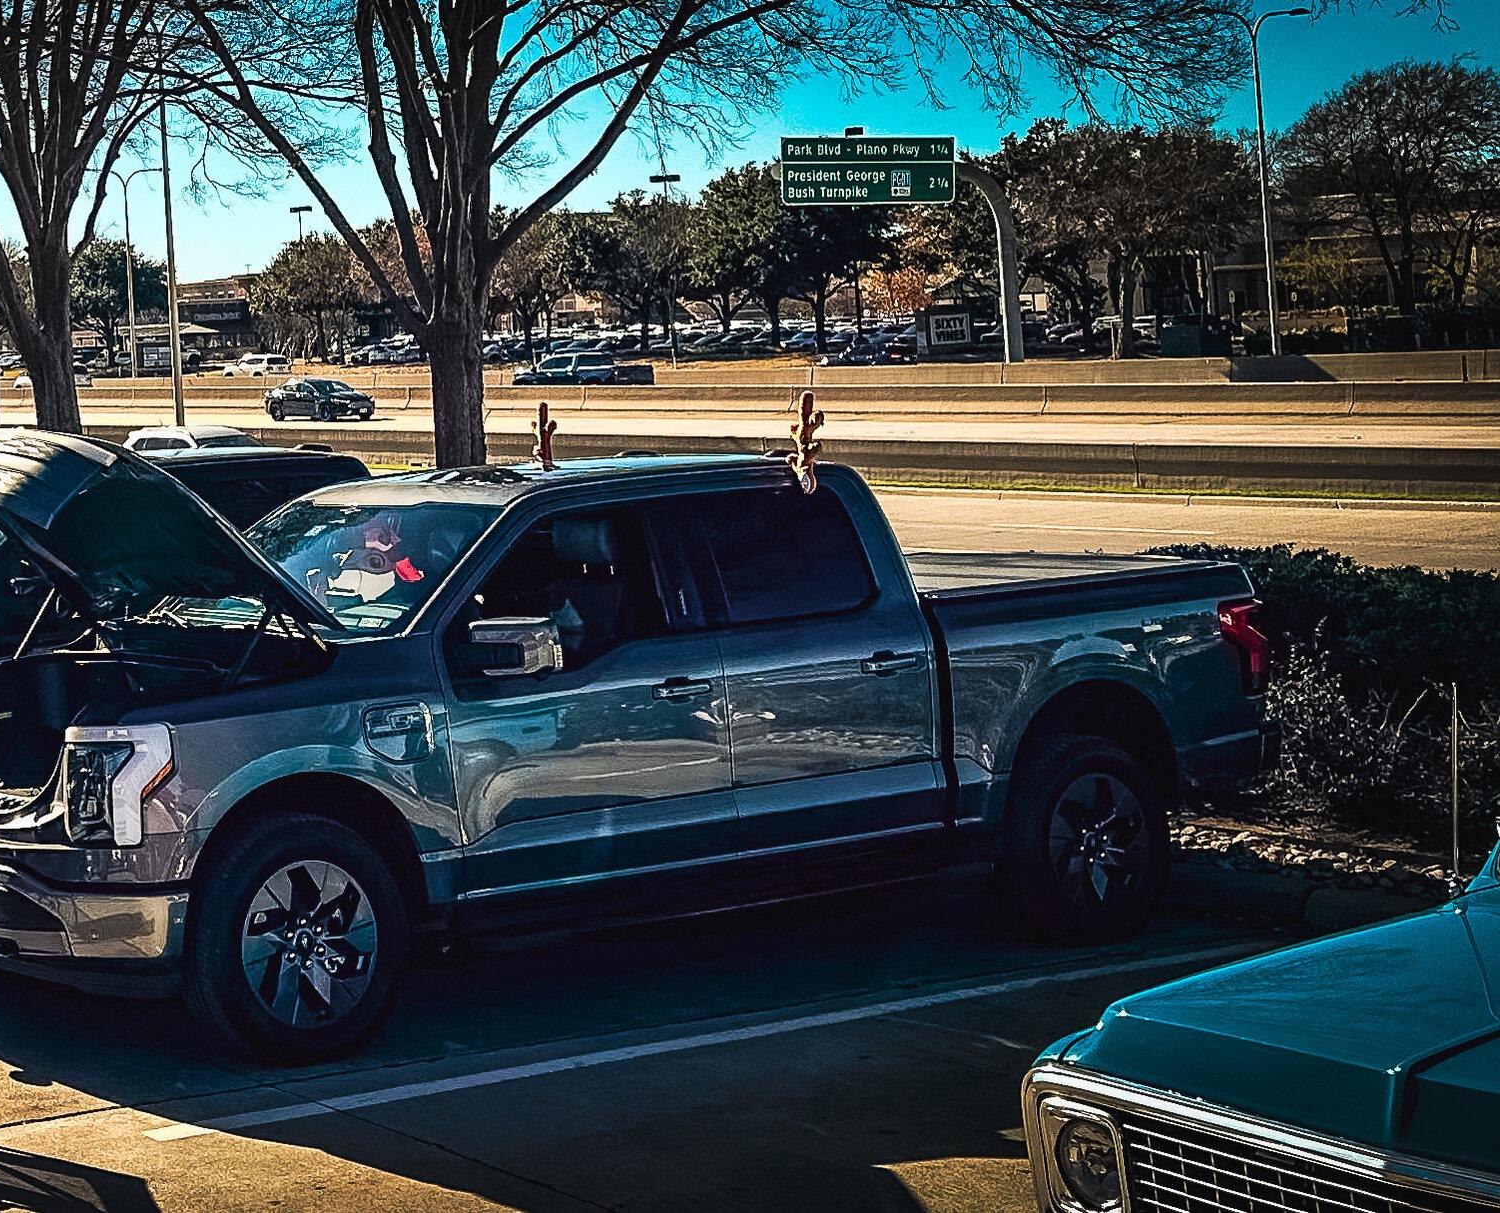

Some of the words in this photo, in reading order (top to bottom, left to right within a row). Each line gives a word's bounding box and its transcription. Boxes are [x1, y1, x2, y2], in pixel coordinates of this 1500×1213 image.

[787, 144, 813, 156] Park
[817, 143, 841, 156] Blvd
[856, 143, 888, 156] Plano
[893, 143, 920, 158] Pkwy
[787, 170, 841, 182] President
[846, 170, 886, 184] George
[787, 187, 815, 199] Bush
[820, 185, 869, 200] Turnpike
[934, 317, 966, 330] SIXTY
